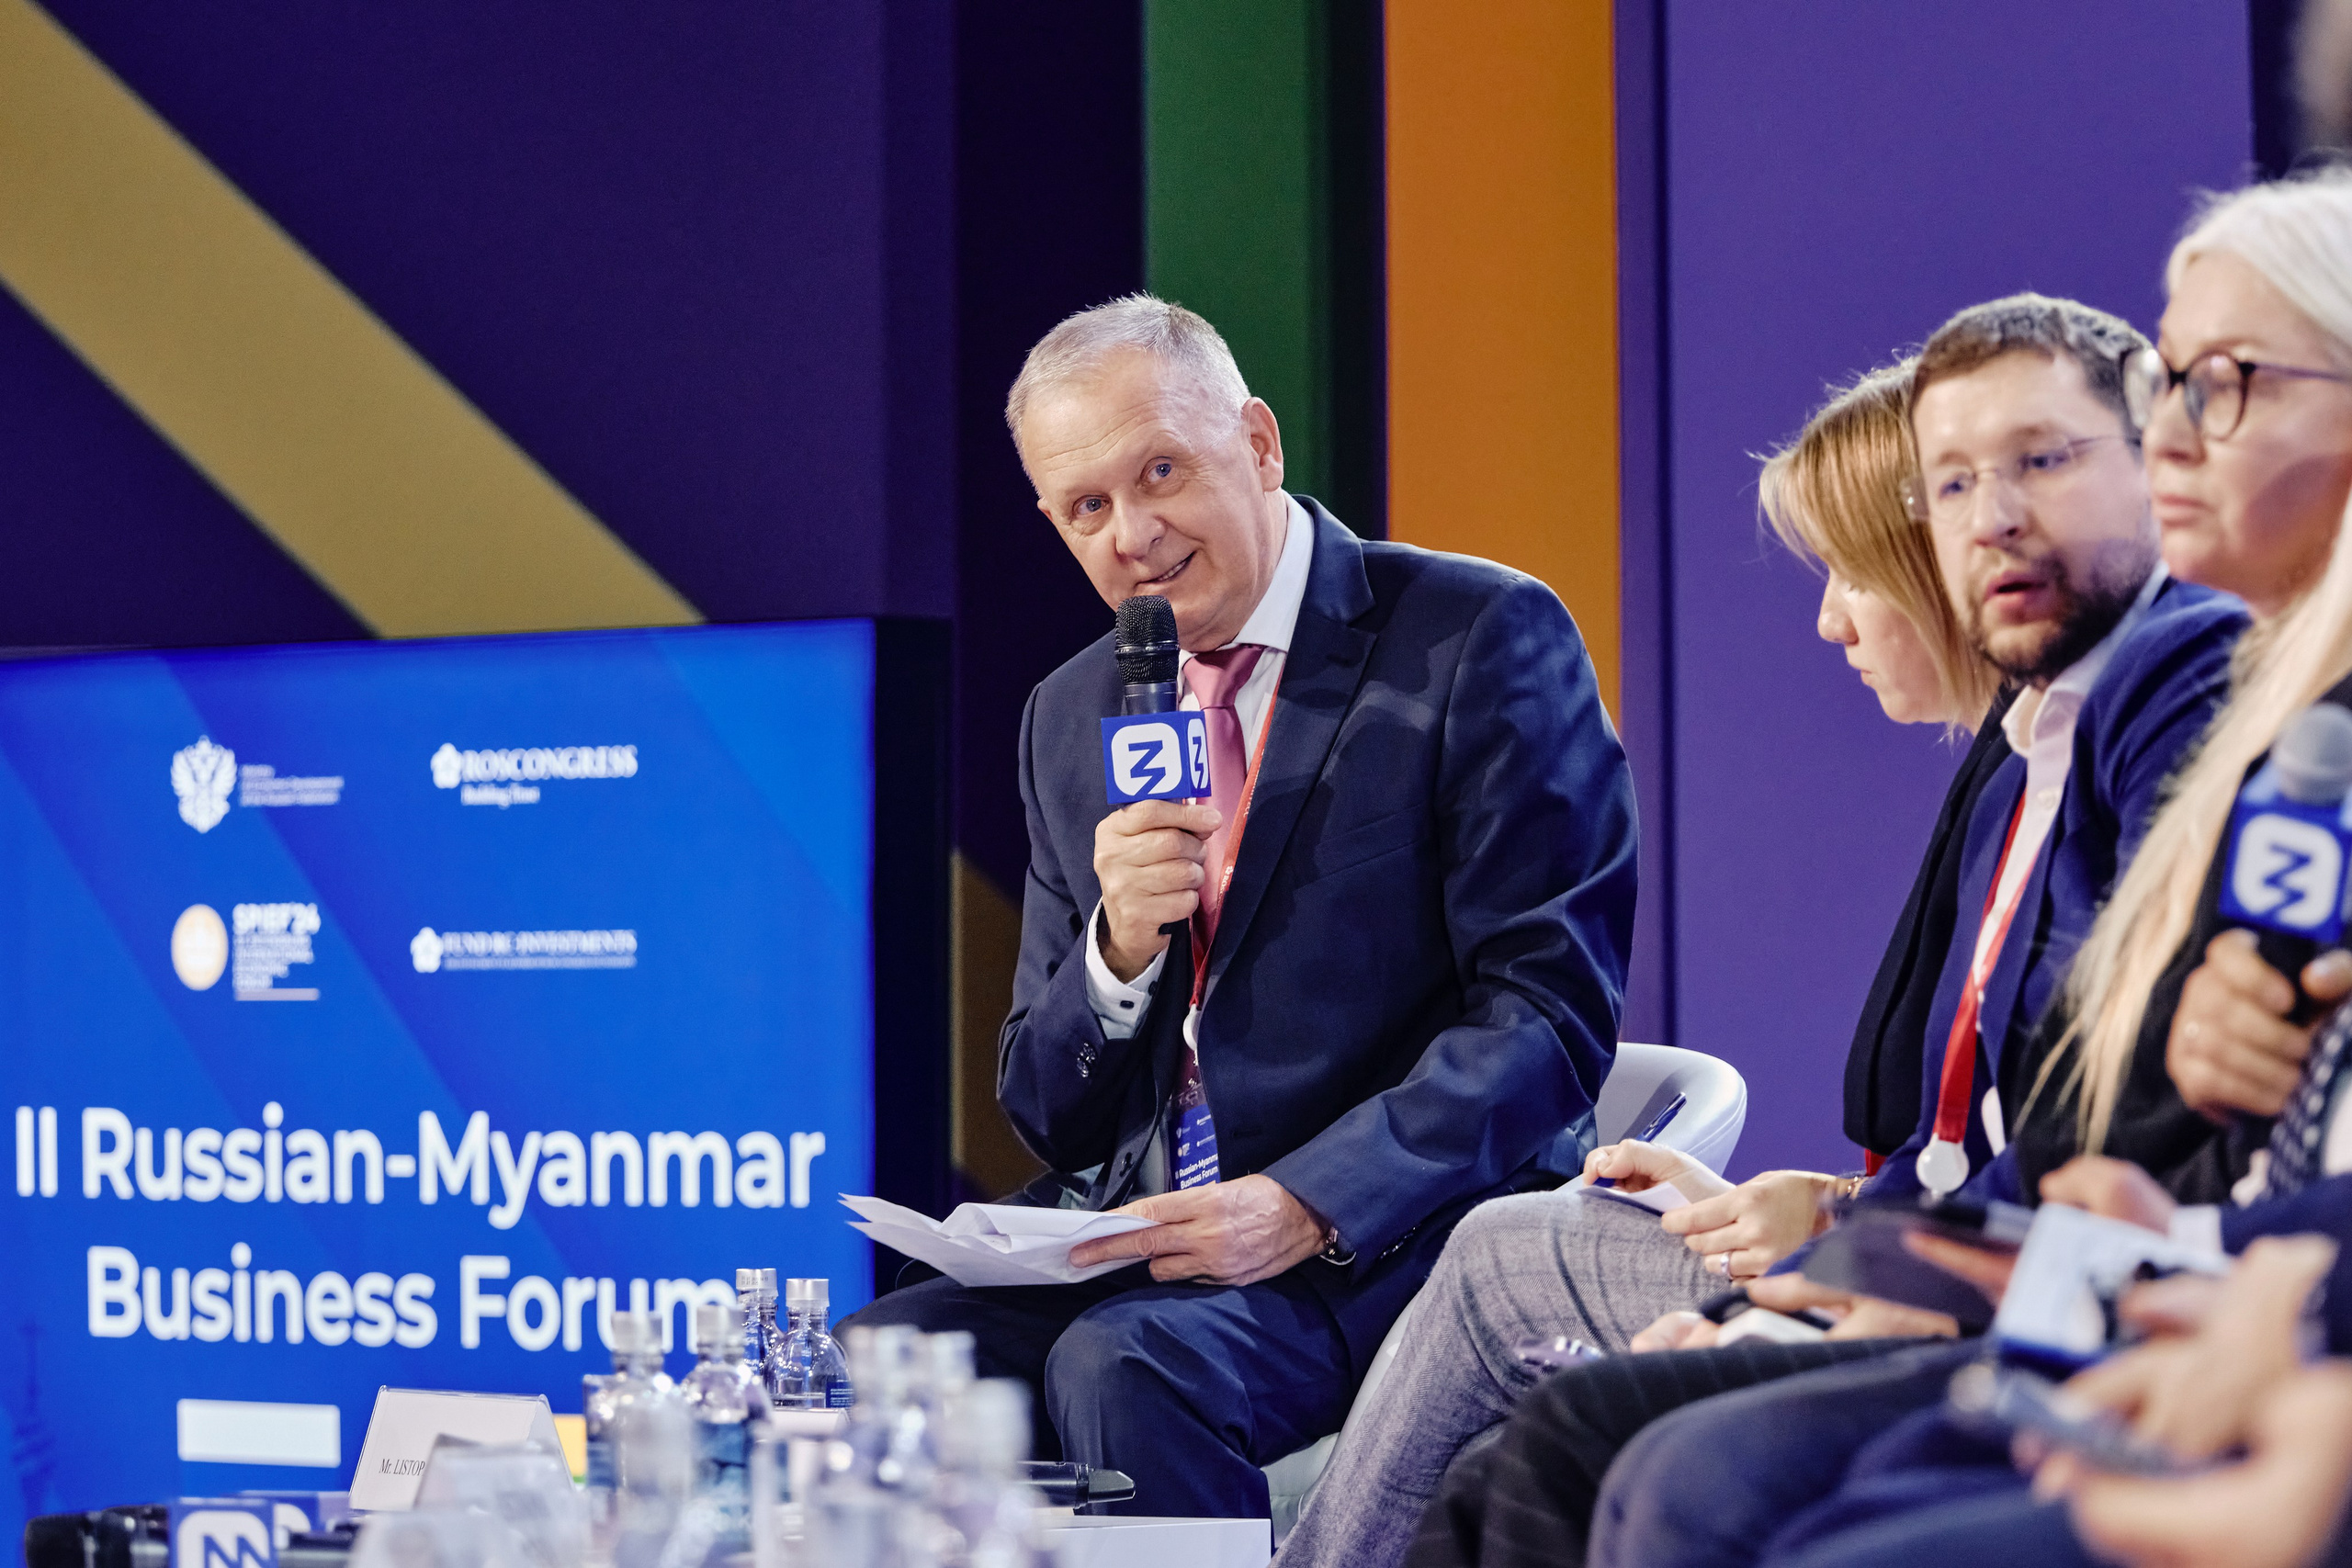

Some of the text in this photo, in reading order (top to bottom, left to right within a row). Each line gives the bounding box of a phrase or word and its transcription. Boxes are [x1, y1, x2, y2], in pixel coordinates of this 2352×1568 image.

[16, 1101, 826, 1230] II Russian-Myanmar
[87, 1241, 738, 1355] Business Forum
[379, 1459, 425, 1476] Mr. LISTOP
